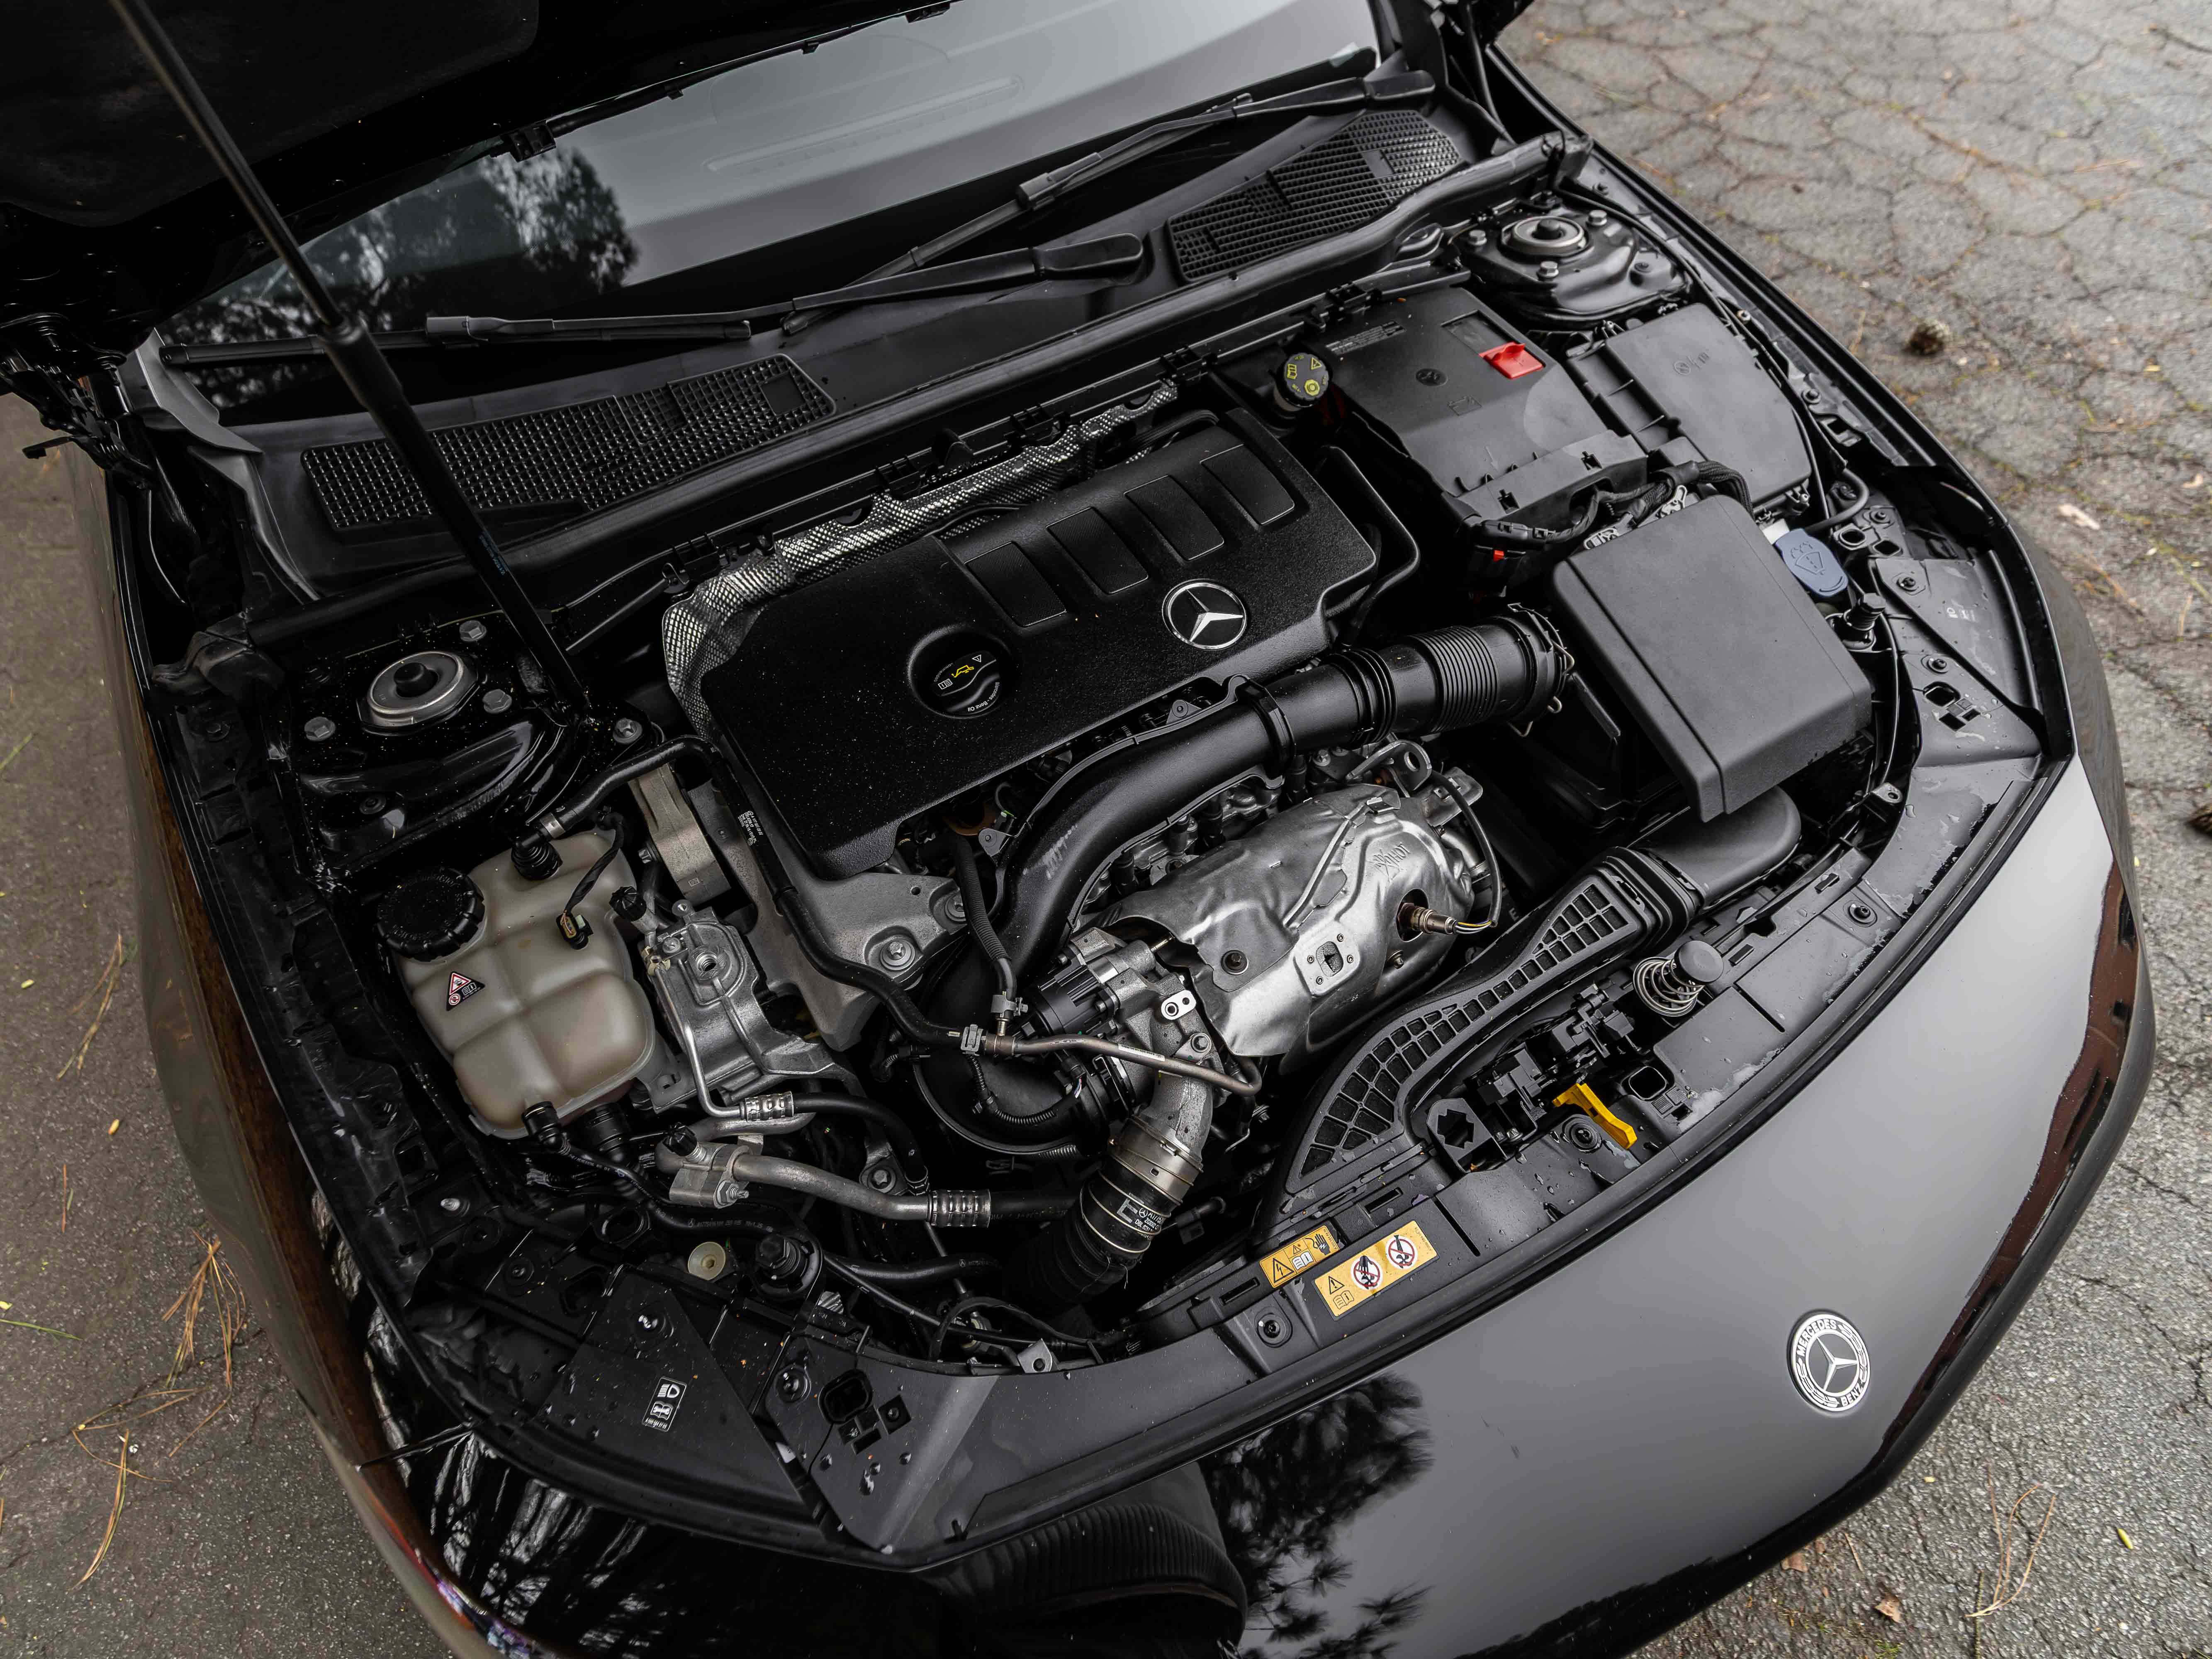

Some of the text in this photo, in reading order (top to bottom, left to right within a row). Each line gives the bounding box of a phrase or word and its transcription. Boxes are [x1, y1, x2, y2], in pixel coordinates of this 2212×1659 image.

[988, 682, 1000, 700] Mercedes
[976, 701, 988, 709] Benz
[1796, 1319, 1837, 1357] MERCEDES
[1840, 1382, 1863, 1407] BENZ
